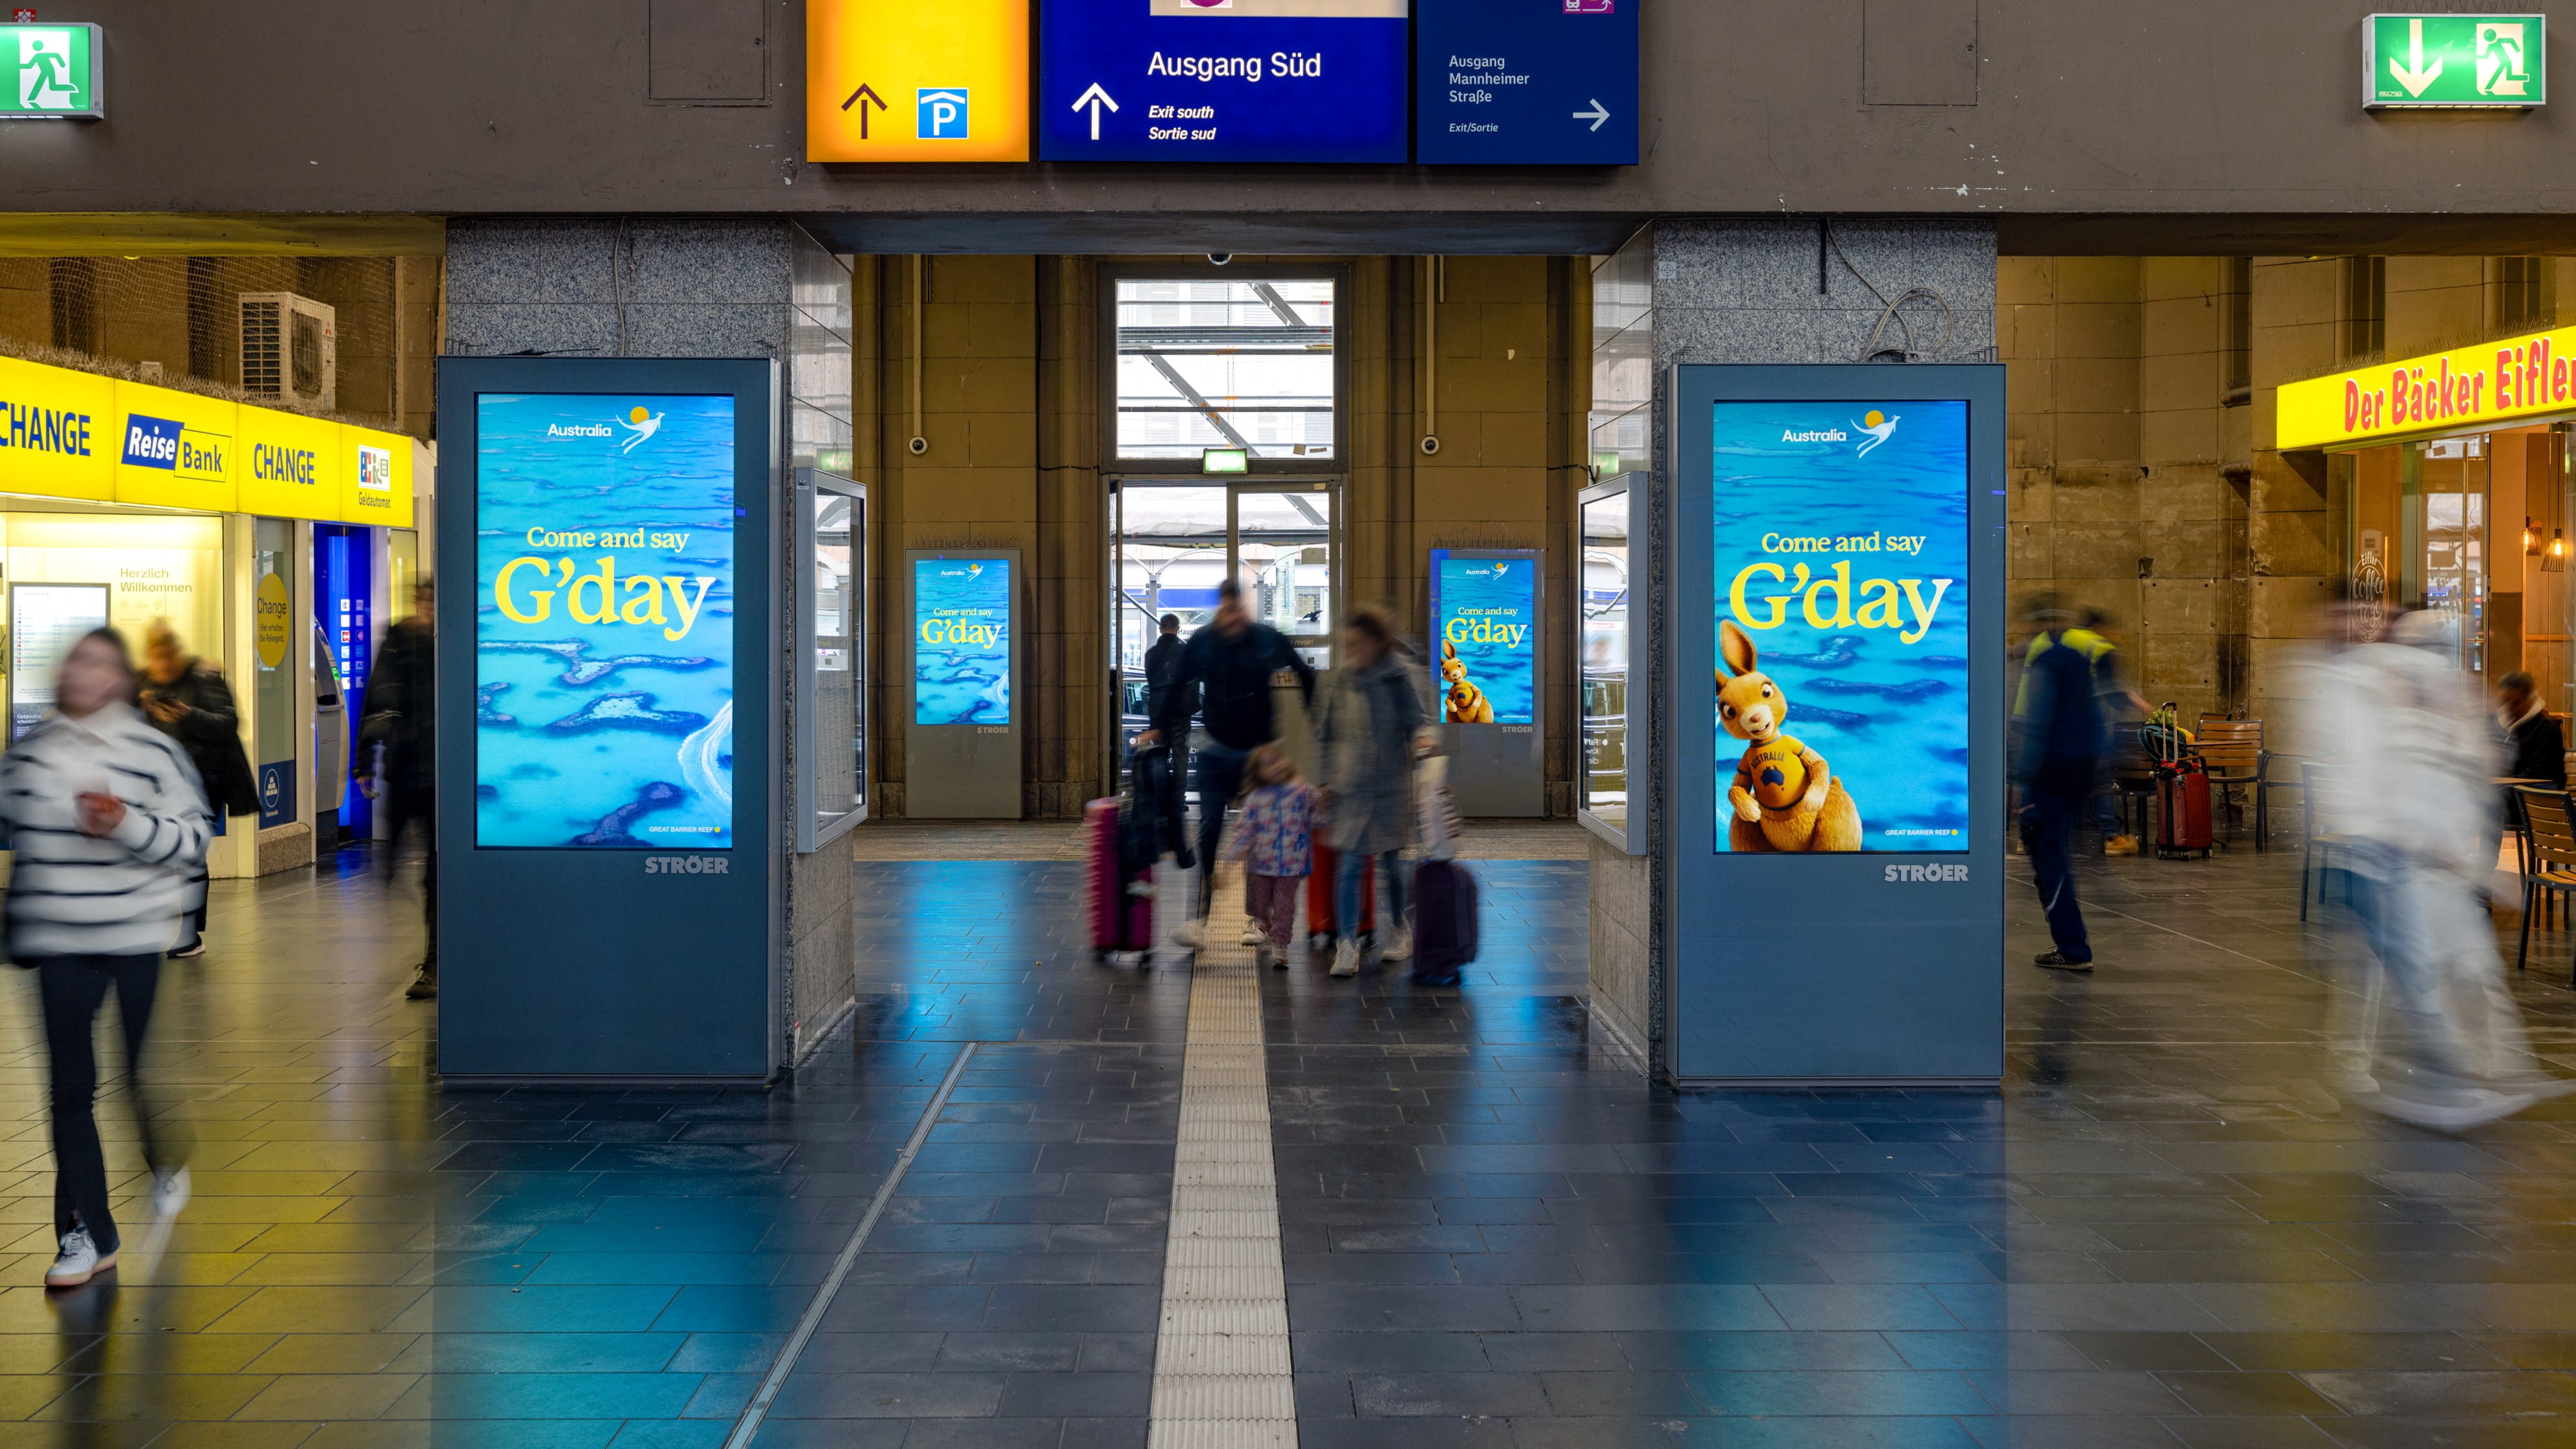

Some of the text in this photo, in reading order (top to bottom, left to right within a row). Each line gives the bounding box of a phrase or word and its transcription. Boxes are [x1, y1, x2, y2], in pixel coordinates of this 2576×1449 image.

[1147, 52, 1321, 82] Ausgang Süd
[1449, 56, 1504, 69] Ausgang
[1449, 72, 1529, 84] Mannheimer
[1449, 90, 1491, 104] Straße
[933, 103, 956, 136] P
[1149, 106, 1214, 118] Exit south
[1149, 127, 1216, 140] Sortie sud
[1449, 123, 1498, 132] Exit/Sortie
[2345, 378, 2385, 433] Der
[2392, 356, 2484, 425] Bäcker
[548, 424, 611, 437] Australia
[1782, 429, 1846, 442] Australia
[129, 426, 222, 473] Reise Bank
[254, 443, 315, 484] CHANGE
[359, 491, 391, 508] Geldautomat
[527, 527, 689, 552] Come and say
[1762, 532, 1926, 556] Come and say
[2361, 551, 2378, 566] Eifler
[121, 568, 169, 578] Herzlich
[121, 582, 193, 592] Willkommen
[2352, 568, 2385, 601] coffee
[258, 597, 286, 619] Change
[978, 609, 993, 617] say
[269, 624, 284, 632] erhalten
[1751, 752, 1784, 769] AUSTRALIA
[645, 856, 729, 874] STRÖER
[1885, 863, 1969, 882] STRÖER
